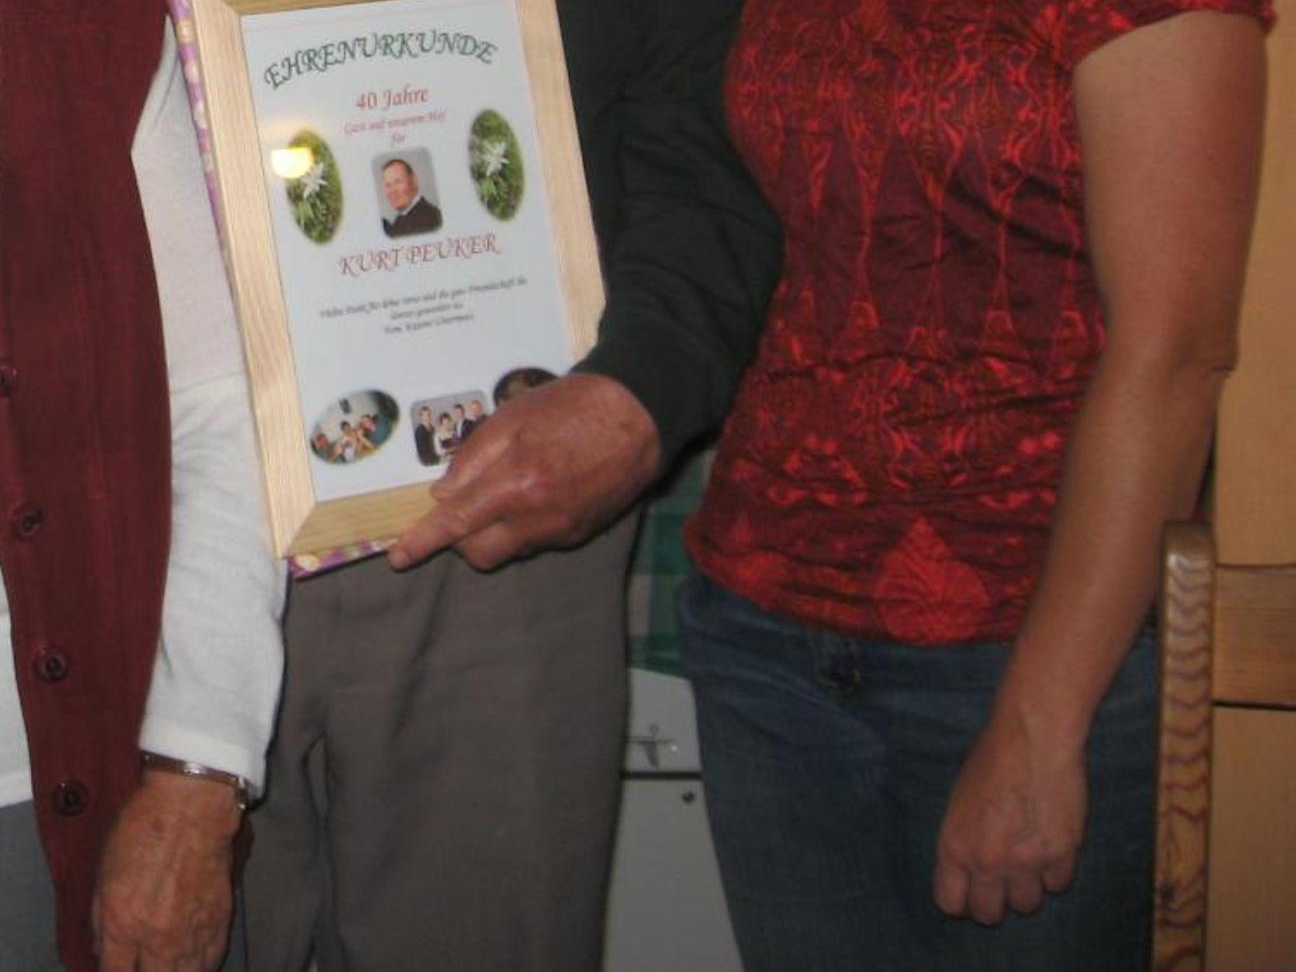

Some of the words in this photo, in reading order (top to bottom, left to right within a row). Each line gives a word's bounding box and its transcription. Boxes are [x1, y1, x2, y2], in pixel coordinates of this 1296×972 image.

[264, 29, 498, 91] EHRENURKUNDE
[355, 92, 378, 109] 40
[382, 84, 430, 110] Jahre
[338, 248, 400, 277] KURT
[405, 232, 501, 264] PEUKER
